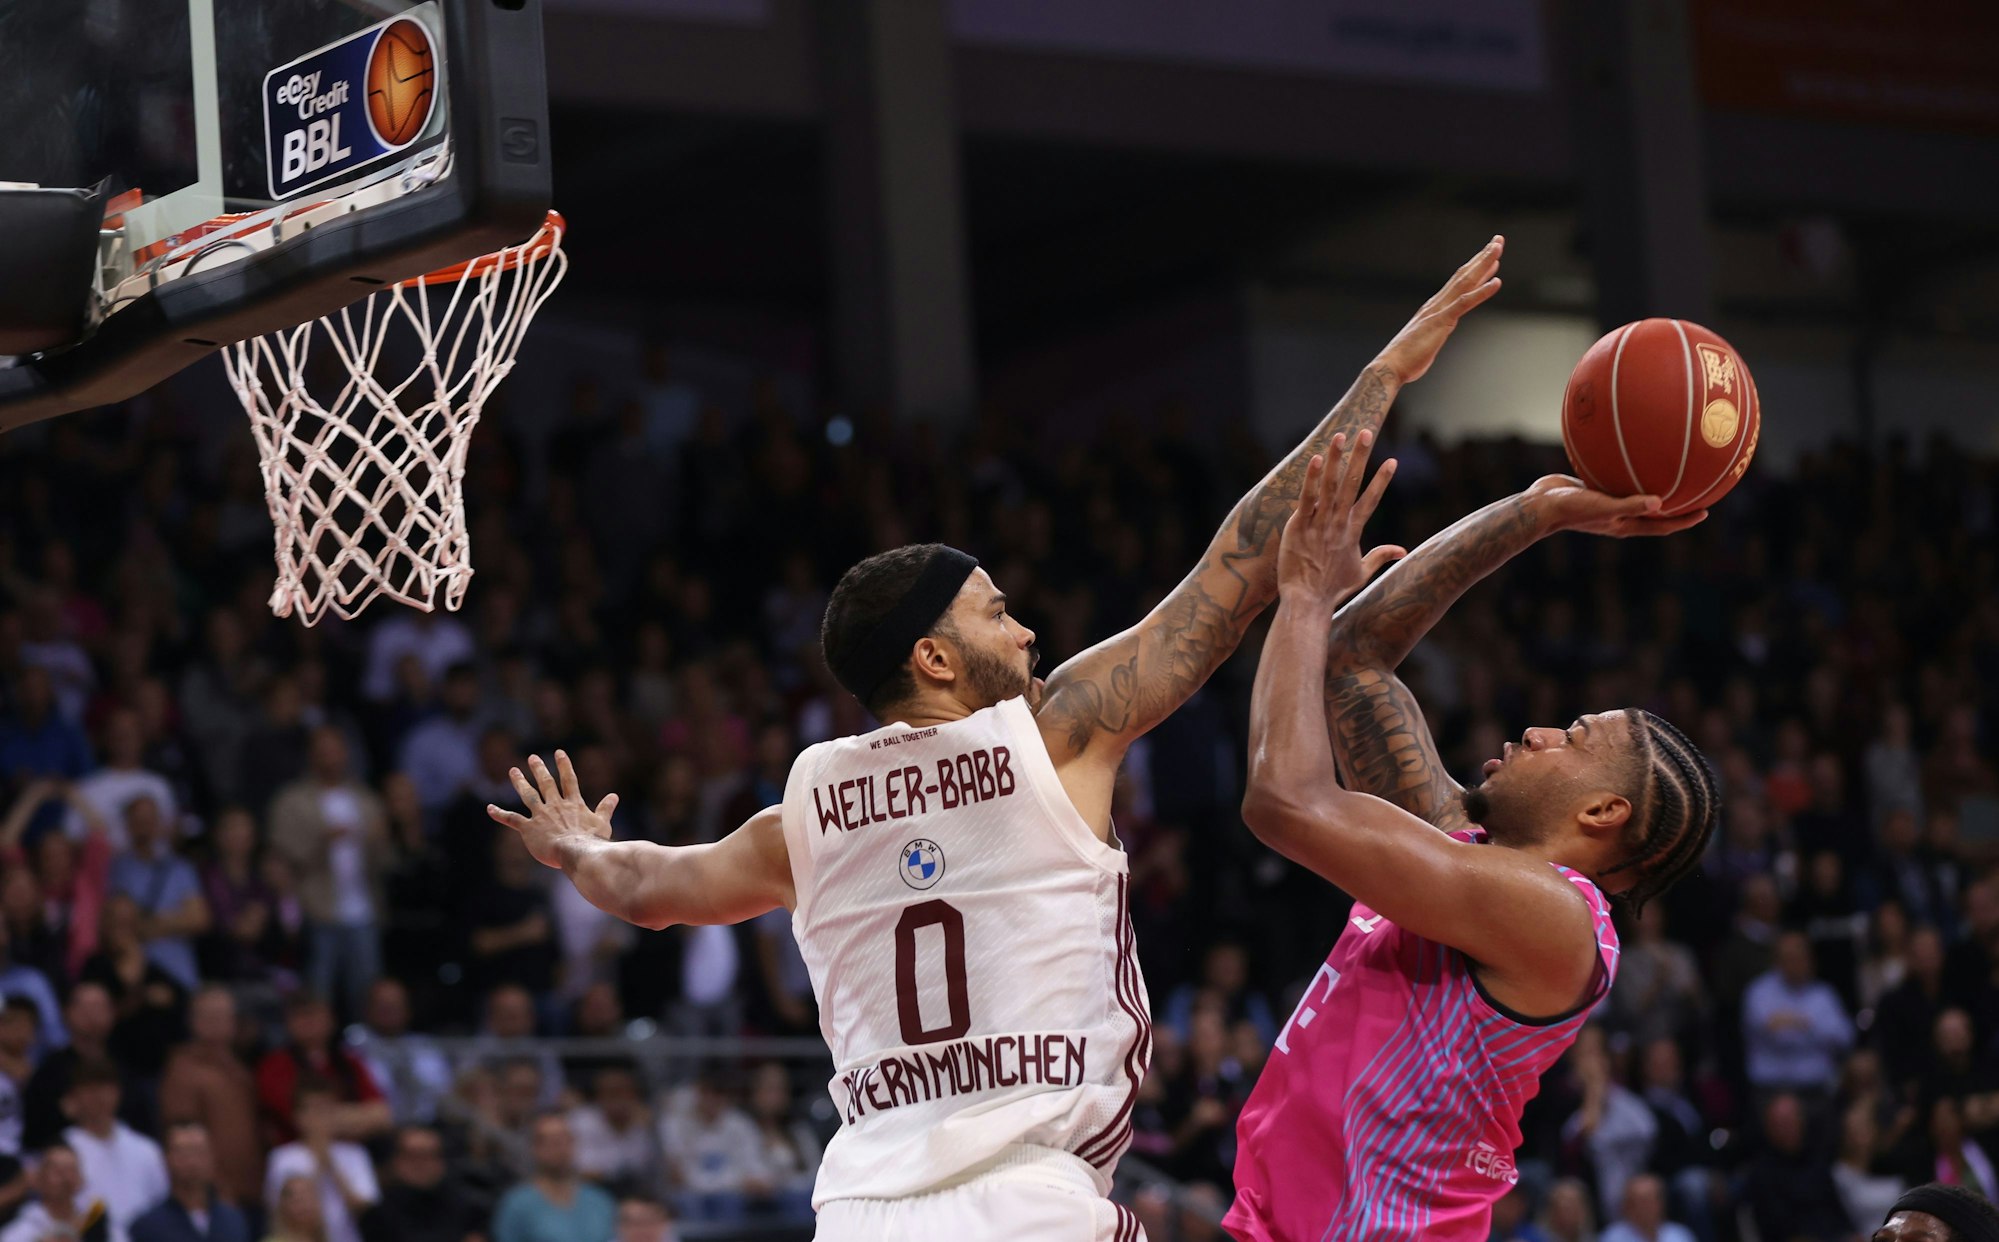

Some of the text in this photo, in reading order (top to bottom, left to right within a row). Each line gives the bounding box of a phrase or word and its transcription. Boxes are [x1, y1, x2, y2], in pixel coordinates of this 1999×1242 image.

[298, 79, 350, 120] Credit
[281, 112, 351, 184] BBL
[870, 727, 938, 750] WE BALL TOGETHER
[813, 746, 1015, 837] WEILER-BABB
[903, 841, 937, 858] BMW
[895, 899, 971, 1045] 0
[924, 1034, 1087, 1099] MÜNCHEN
